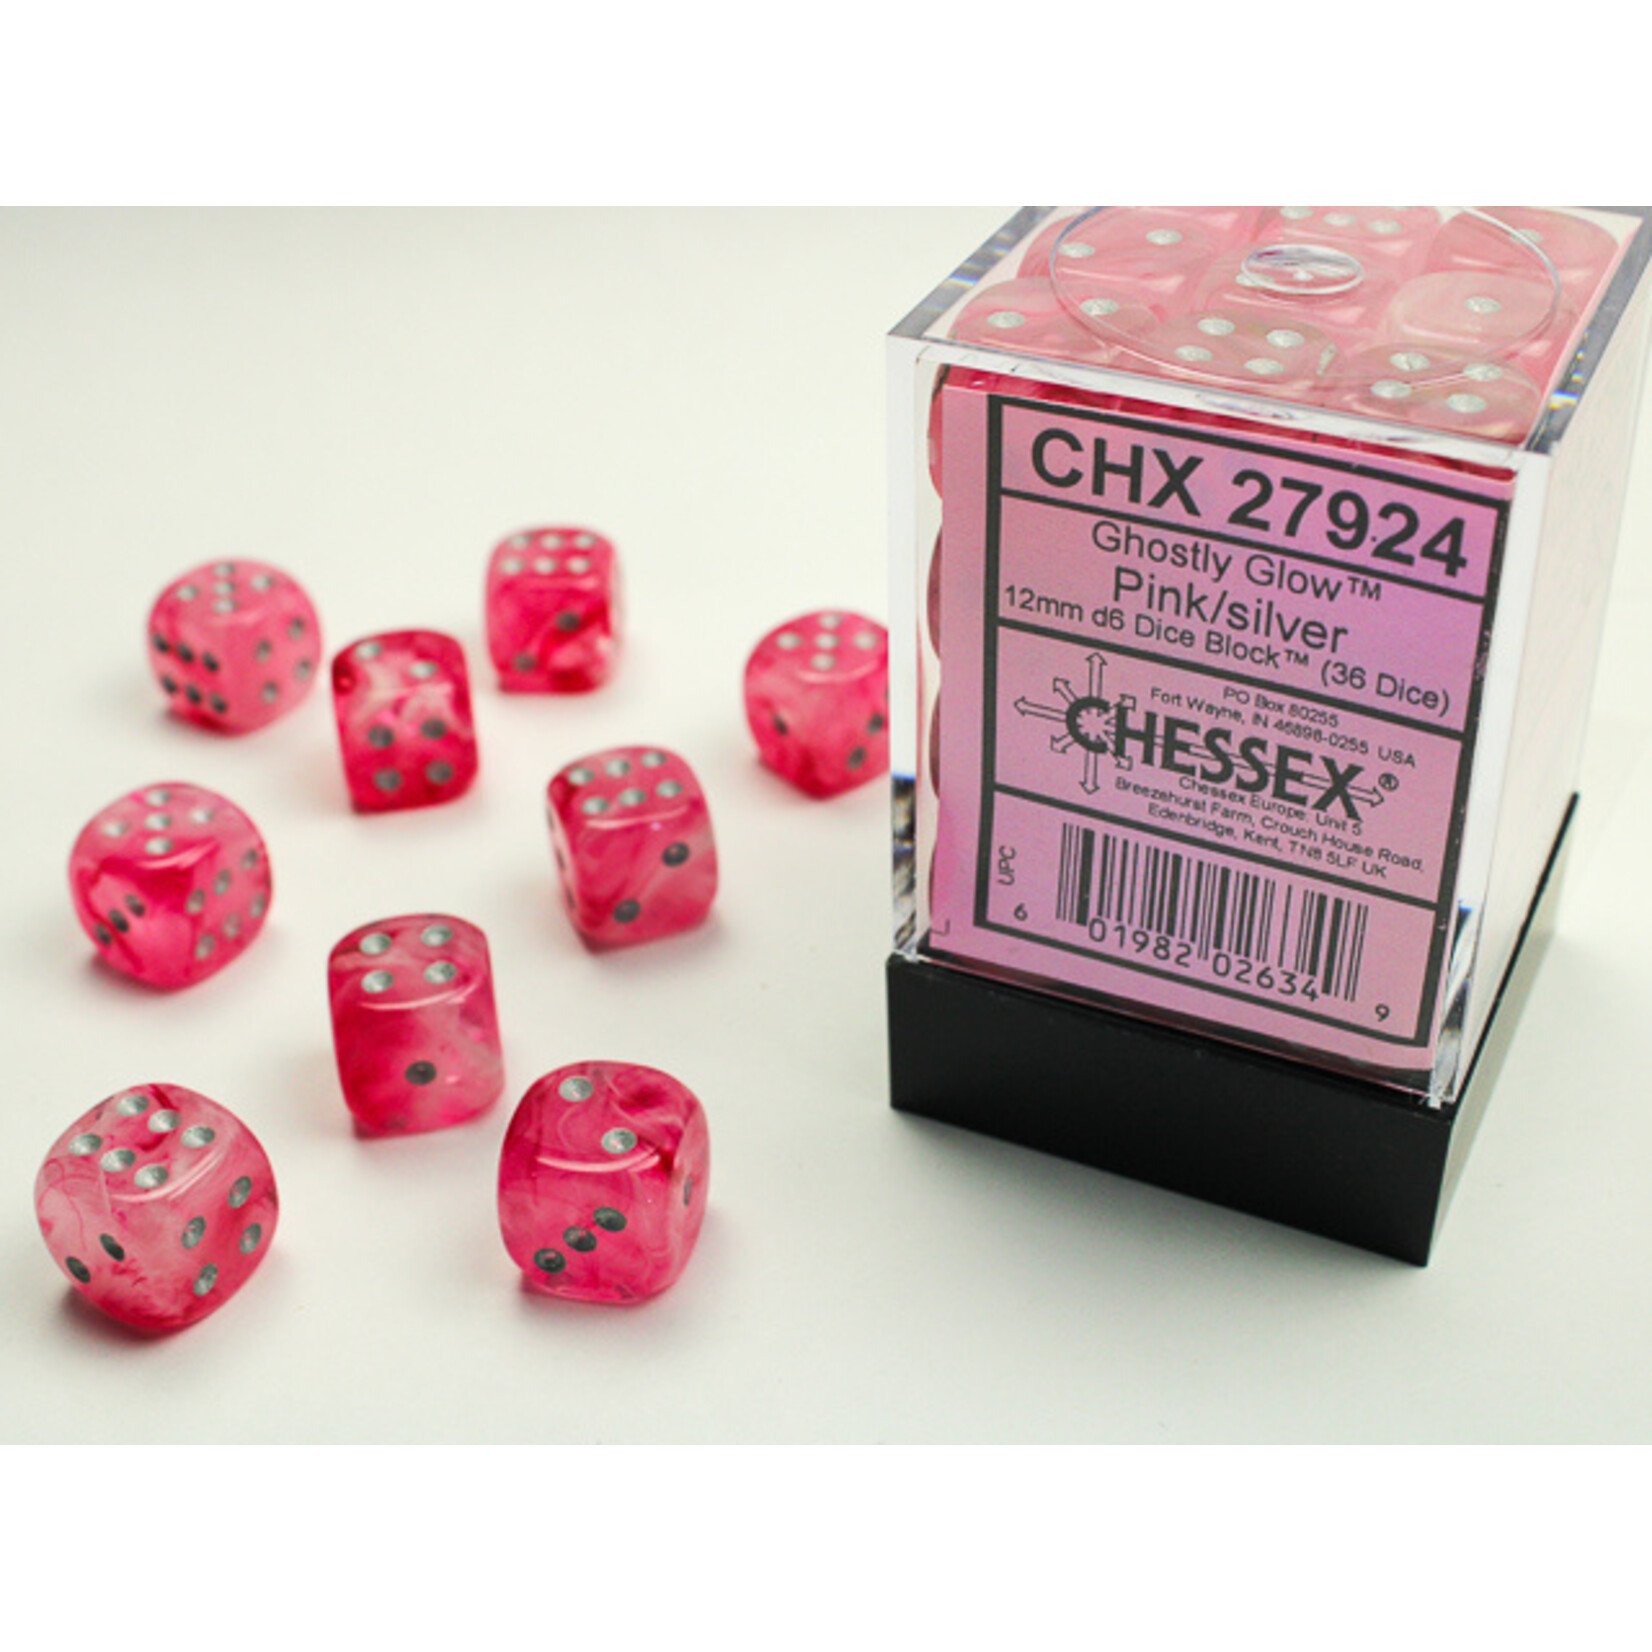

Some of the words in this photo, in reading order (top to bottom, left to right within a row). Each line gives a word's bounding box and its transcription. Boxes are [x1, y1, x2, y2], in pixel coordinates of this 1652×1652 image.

[1031, 428, 1204, 516] CHX
[1227, 469, 1468, 577] 27924
[1092, 520, 1232, 583] Ghostly
[1113, 565, 1348, 653] Pink/silver
[1005, 585, 1084, 622] 12mm
[1091, 606, 1125, 630] d6
[1135, 613, 1195, 647] Dice
[1321, 660, 1367, 690] (36
[1376, 672, 1450, 718] Dice)
[1151, 687, 1182, 707] Fort
[1186, 696, 1245, 725] Wayne,
[1252, 712, 1269, 729] IN
[1377, 745, 1416, 768] USA
[1223, 686, 1250, 704] PO
[1255, 694, 1284, 714] Box
[1288, 703, 1339, 728] 80255
[1115, 776, 1206, 812] Breezehurst
[1210, 802, 1255, 827] Farm,
[1261, 815, 1318, 843] Crouch
[1322, 833, 1374, 857] House
[1148, 802, 1237, 840] Edenbridge,
[1244, 829, 1283, 852] Kent,
[1289, 840, 1322, 860] TN8
[1327, 851, 1357, 867] 5LF
[1362, 861, 1387, 879] UK
[1179, 776, 1246, 803] Chessex
[1315, 812, 1348, 831] Unit
[1352, 822, 1362, 836] 5
[998, 845, 1016, 886] UPC
[1014, 902, 1028, 921] 6
[1089, 918, 1192, 967] 01982
[1213, 953, 1319, 1001] 02634
[1375, 1003, 1390, 1022] 9
